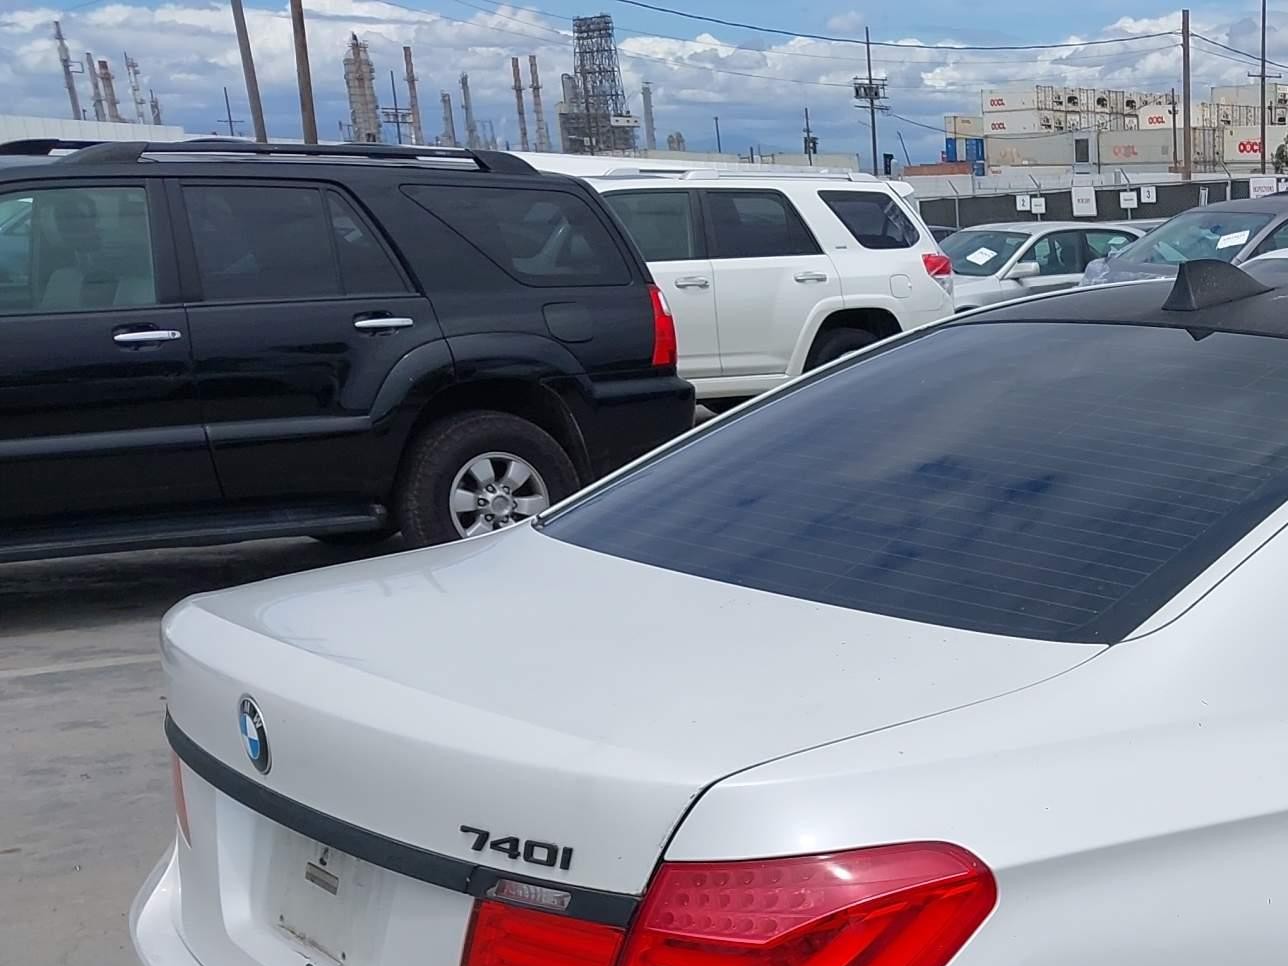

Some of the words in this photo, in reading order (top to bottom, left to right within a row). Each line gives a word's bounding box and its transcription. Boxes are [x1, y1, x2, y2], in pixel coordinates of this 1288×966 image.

[990, 98, 1006, 107] OOCL
[1147, 115, 1166, 125] OOCL
[991, 122, 1007, 131] OOCL
[1146, 190, 1151, 199] 3
[1021, 198, 1026, 207] 2
